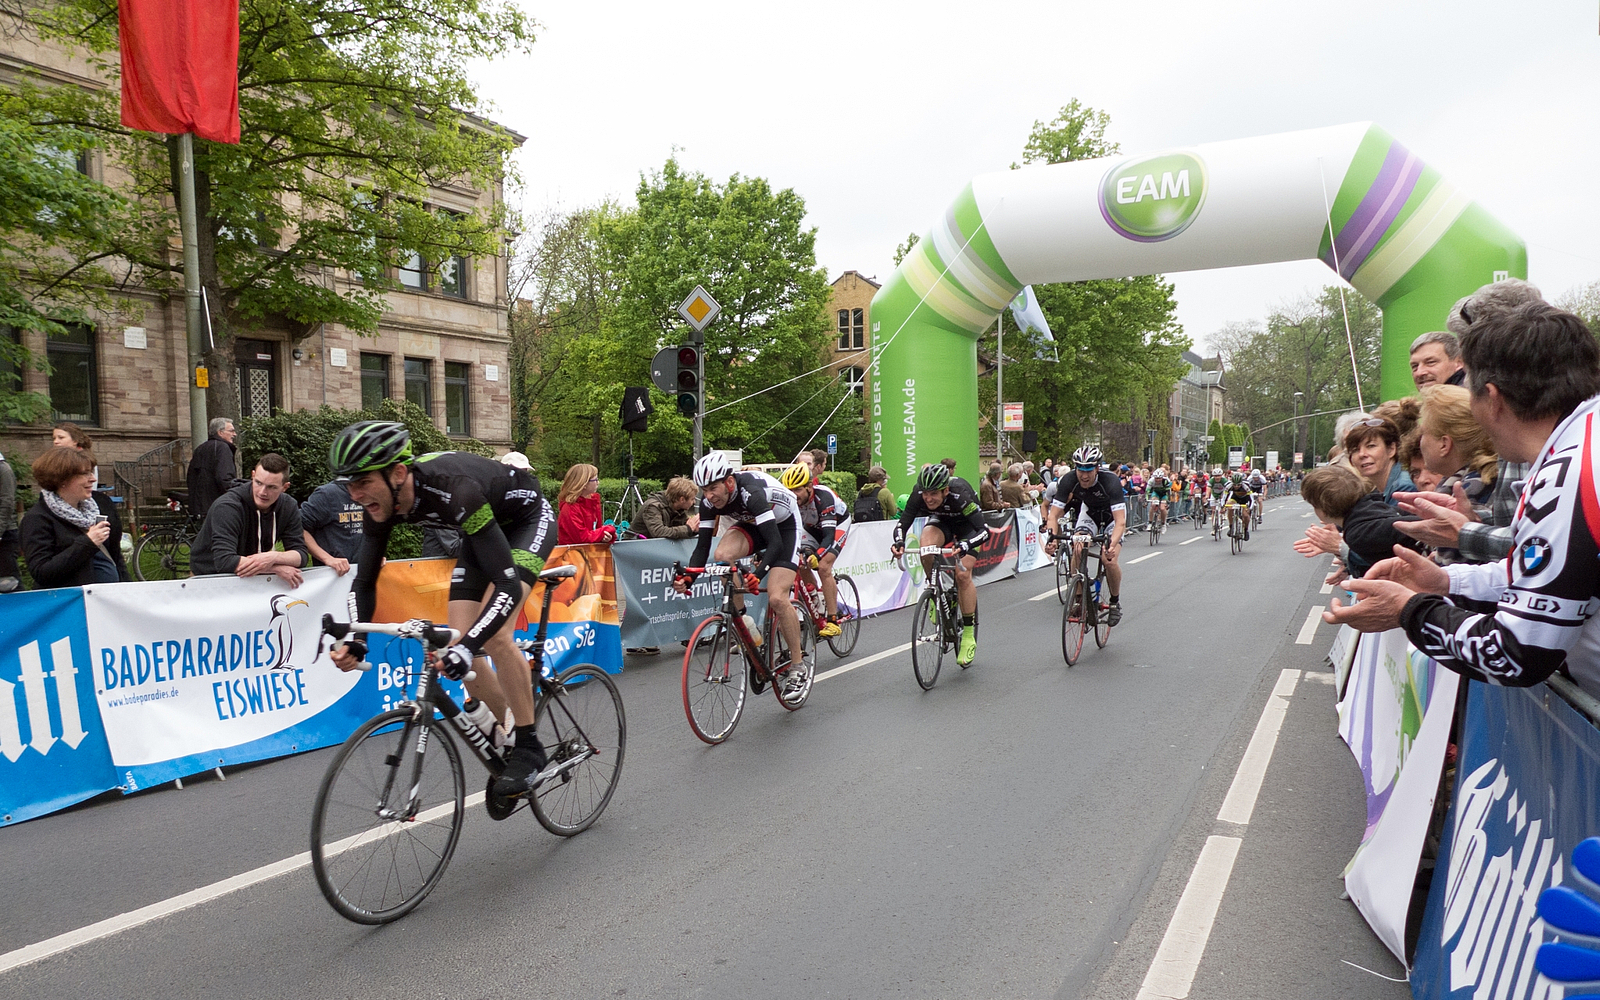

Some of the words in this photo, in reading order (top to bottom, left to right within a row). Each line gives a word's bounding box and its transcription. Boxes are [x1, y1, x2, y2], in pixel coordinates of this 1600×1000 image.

[1117, 169, 1190, 204] EAM
[873, 381, 882, 417] DER
[873, 420, 882, 456] AUS
[902, 378, 916, 476] www.EAM.de
[467, 592, 509, 638] GREEN'N
[501, 596, 515, 616] FIT
[573, 623, 596, 649] Sie
[101, 628, 276, 690] BADEPARADIES
[378, 656, 413, 691] Bei
[108, 686, 179, 708] www.badeparadies.de
[212, 668, 309, 720] EISWIESE
[125, 770, 138, 790] BASTA
